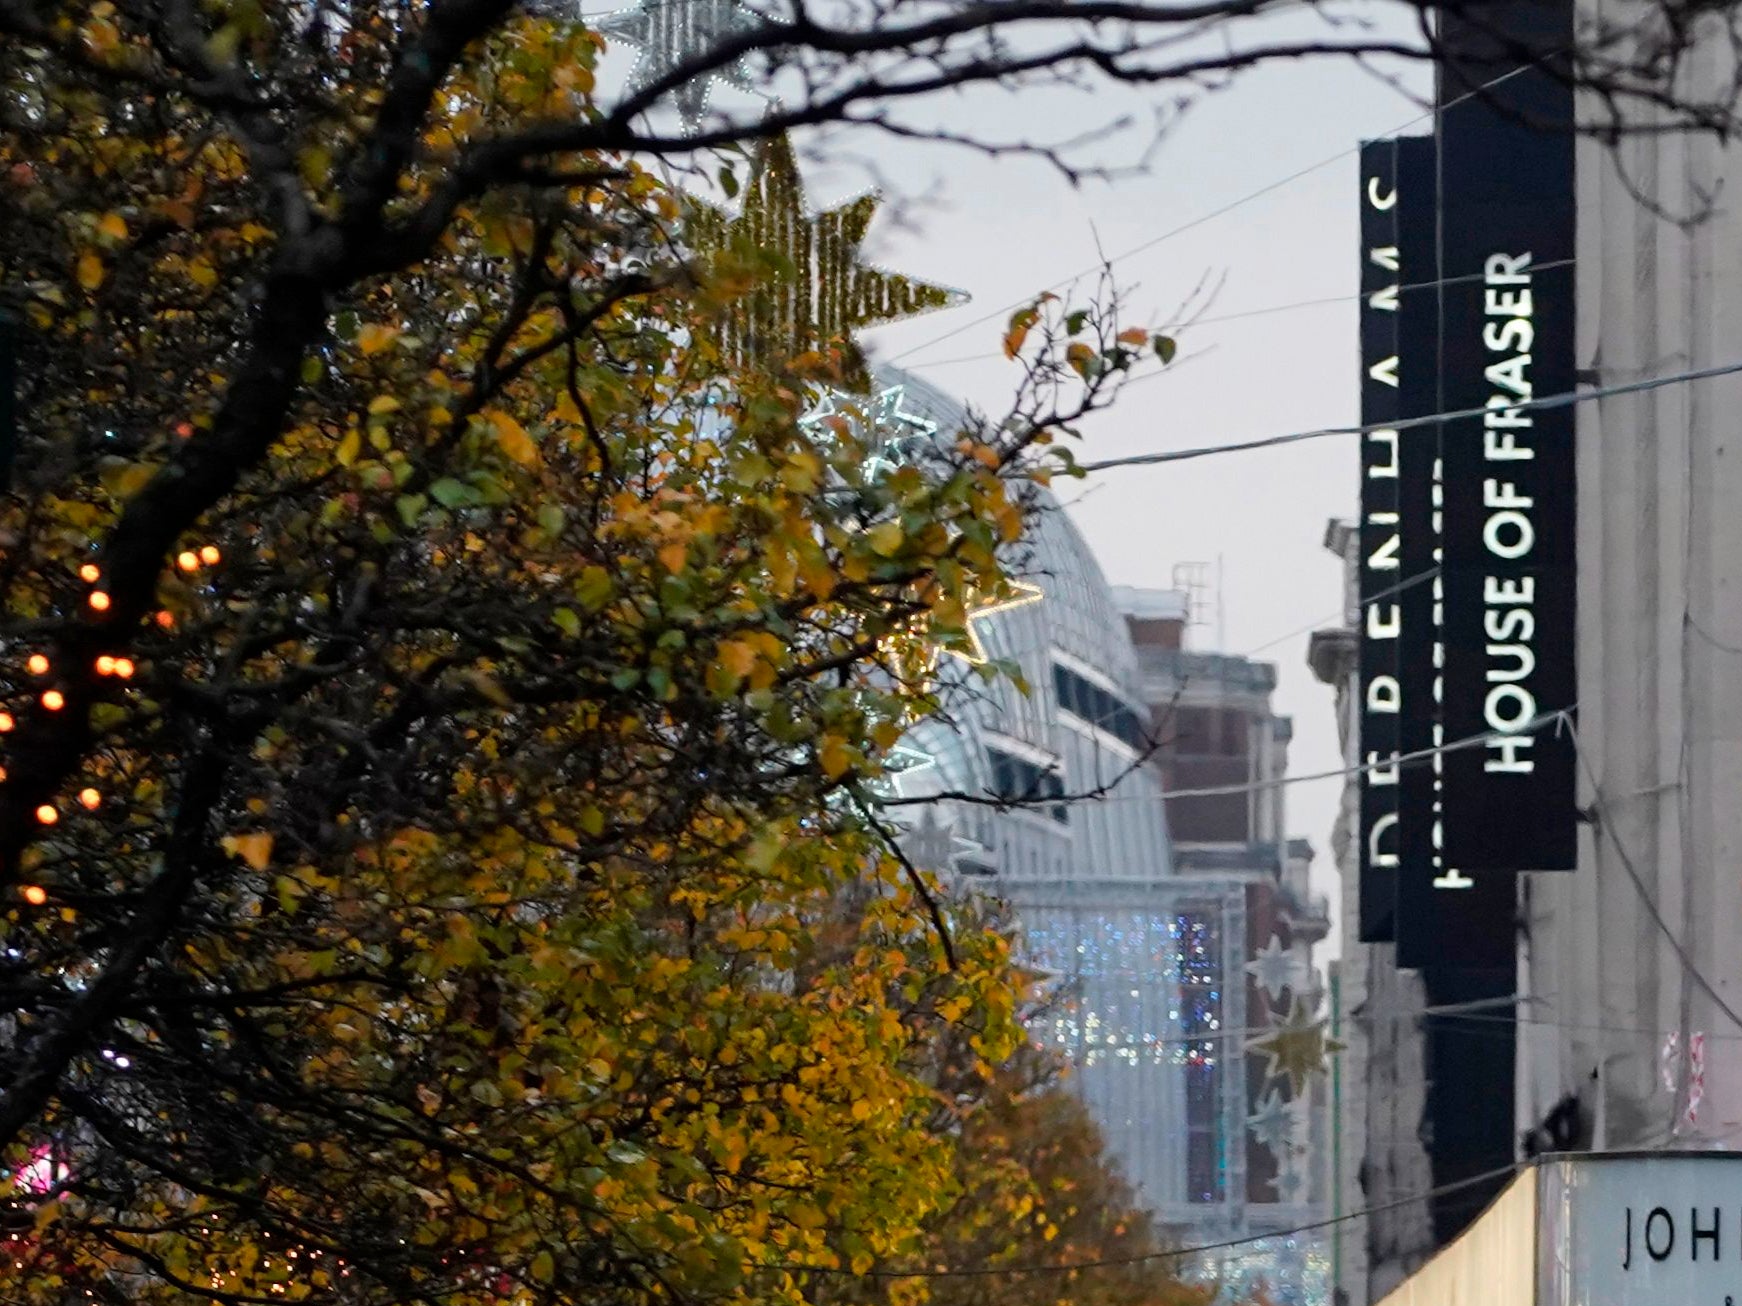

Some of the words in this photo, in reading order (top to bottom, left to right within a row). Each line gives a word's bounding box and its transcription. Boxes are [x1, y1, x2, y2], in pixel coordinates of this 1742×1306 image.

[1483, 251, 1535, 461] FRASER
[1483, 478, 1535, 559] OF
[1483, 575, 1536, 773] HOUSE
